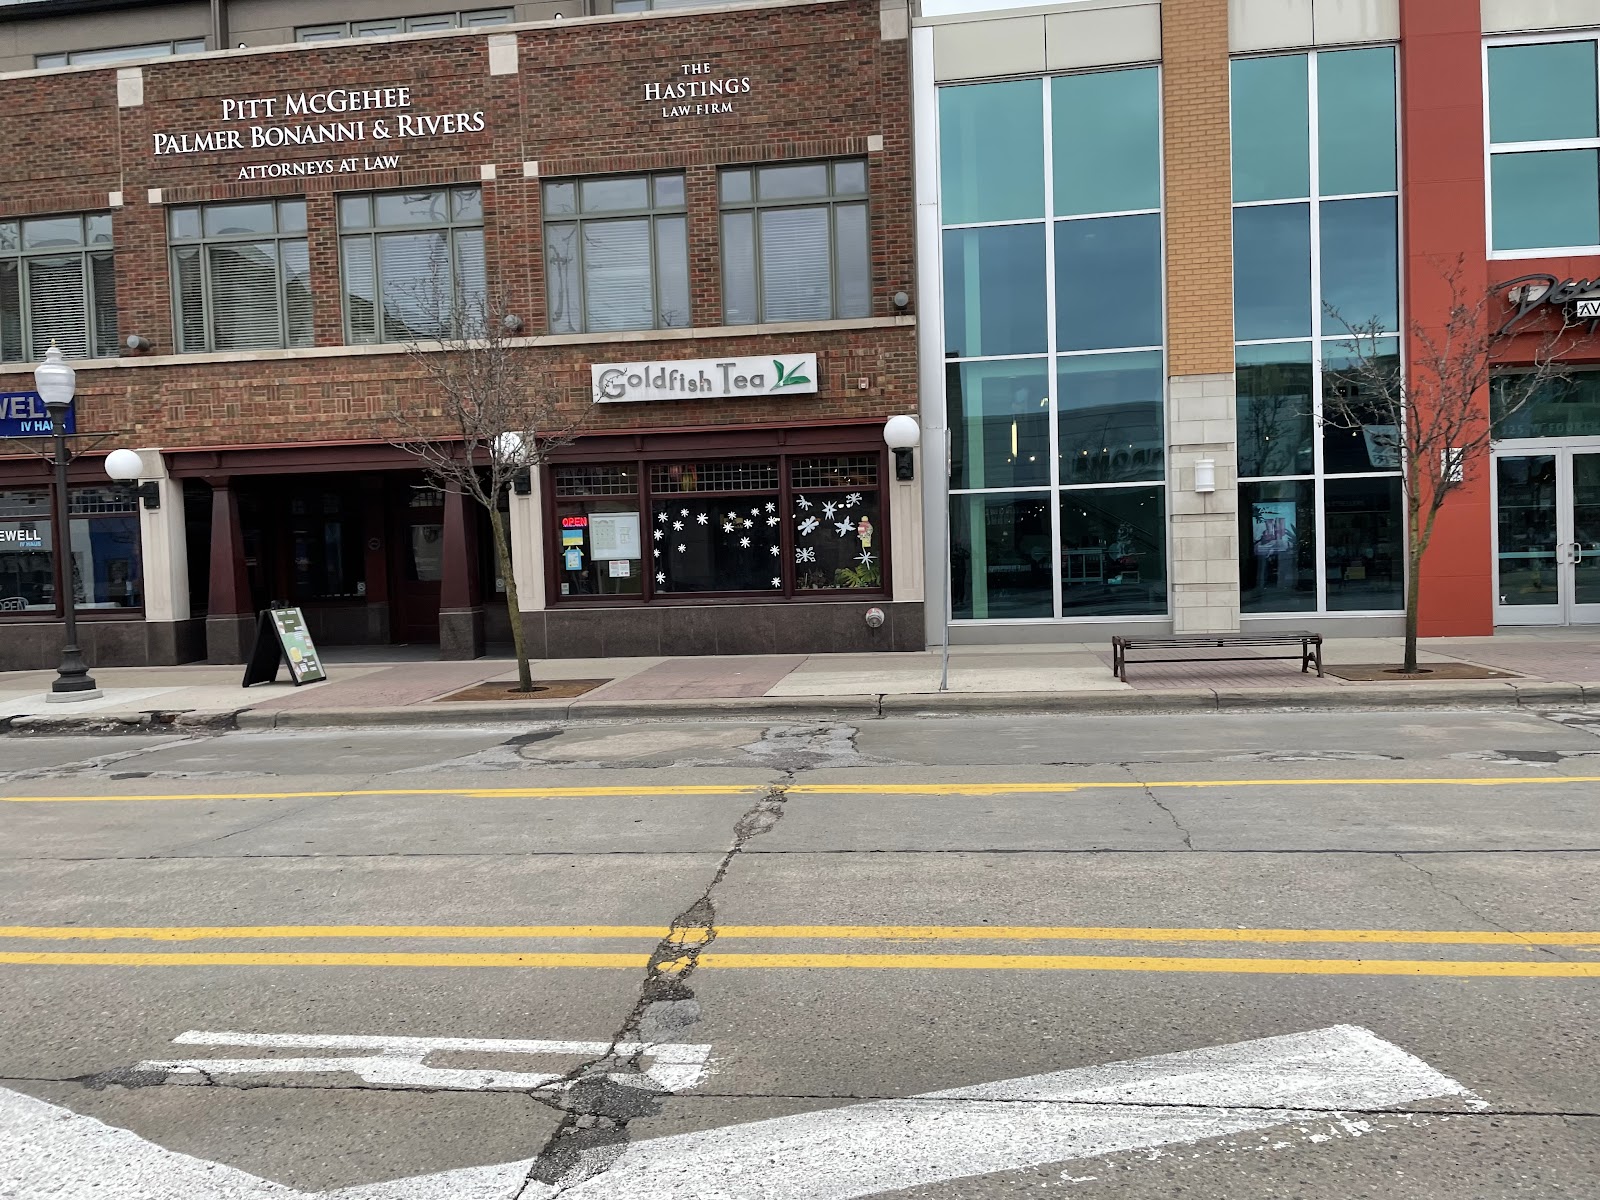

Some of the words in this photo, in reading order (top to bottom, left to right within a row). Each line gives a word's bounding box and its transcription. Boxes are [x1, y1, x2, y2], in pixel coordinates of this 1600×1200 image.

[681, 62, 711, 75] THE
[643, 77, 751, 101] HASTINGS
[220, 98, 277, 121] PITT
[662, 105, 691, 118] LAW
[696, 101, 733, 115] FIRM
[153, 130, 244, 155] PALMER
[250, 120, 365, 150] BONANNI
[372, 119, 390, 139] &
[398, 111, 486, 138] RIVERS
[237, 160, 334, 180] ATTORNEYS
[338, 157, 360, 173] AT
[364, 154, 400, 171] LAW
[598, 365, 713, 400] Goldfish
[716, 362, 765, 395] Tea
[562, 516, 588, 528] OPEN
